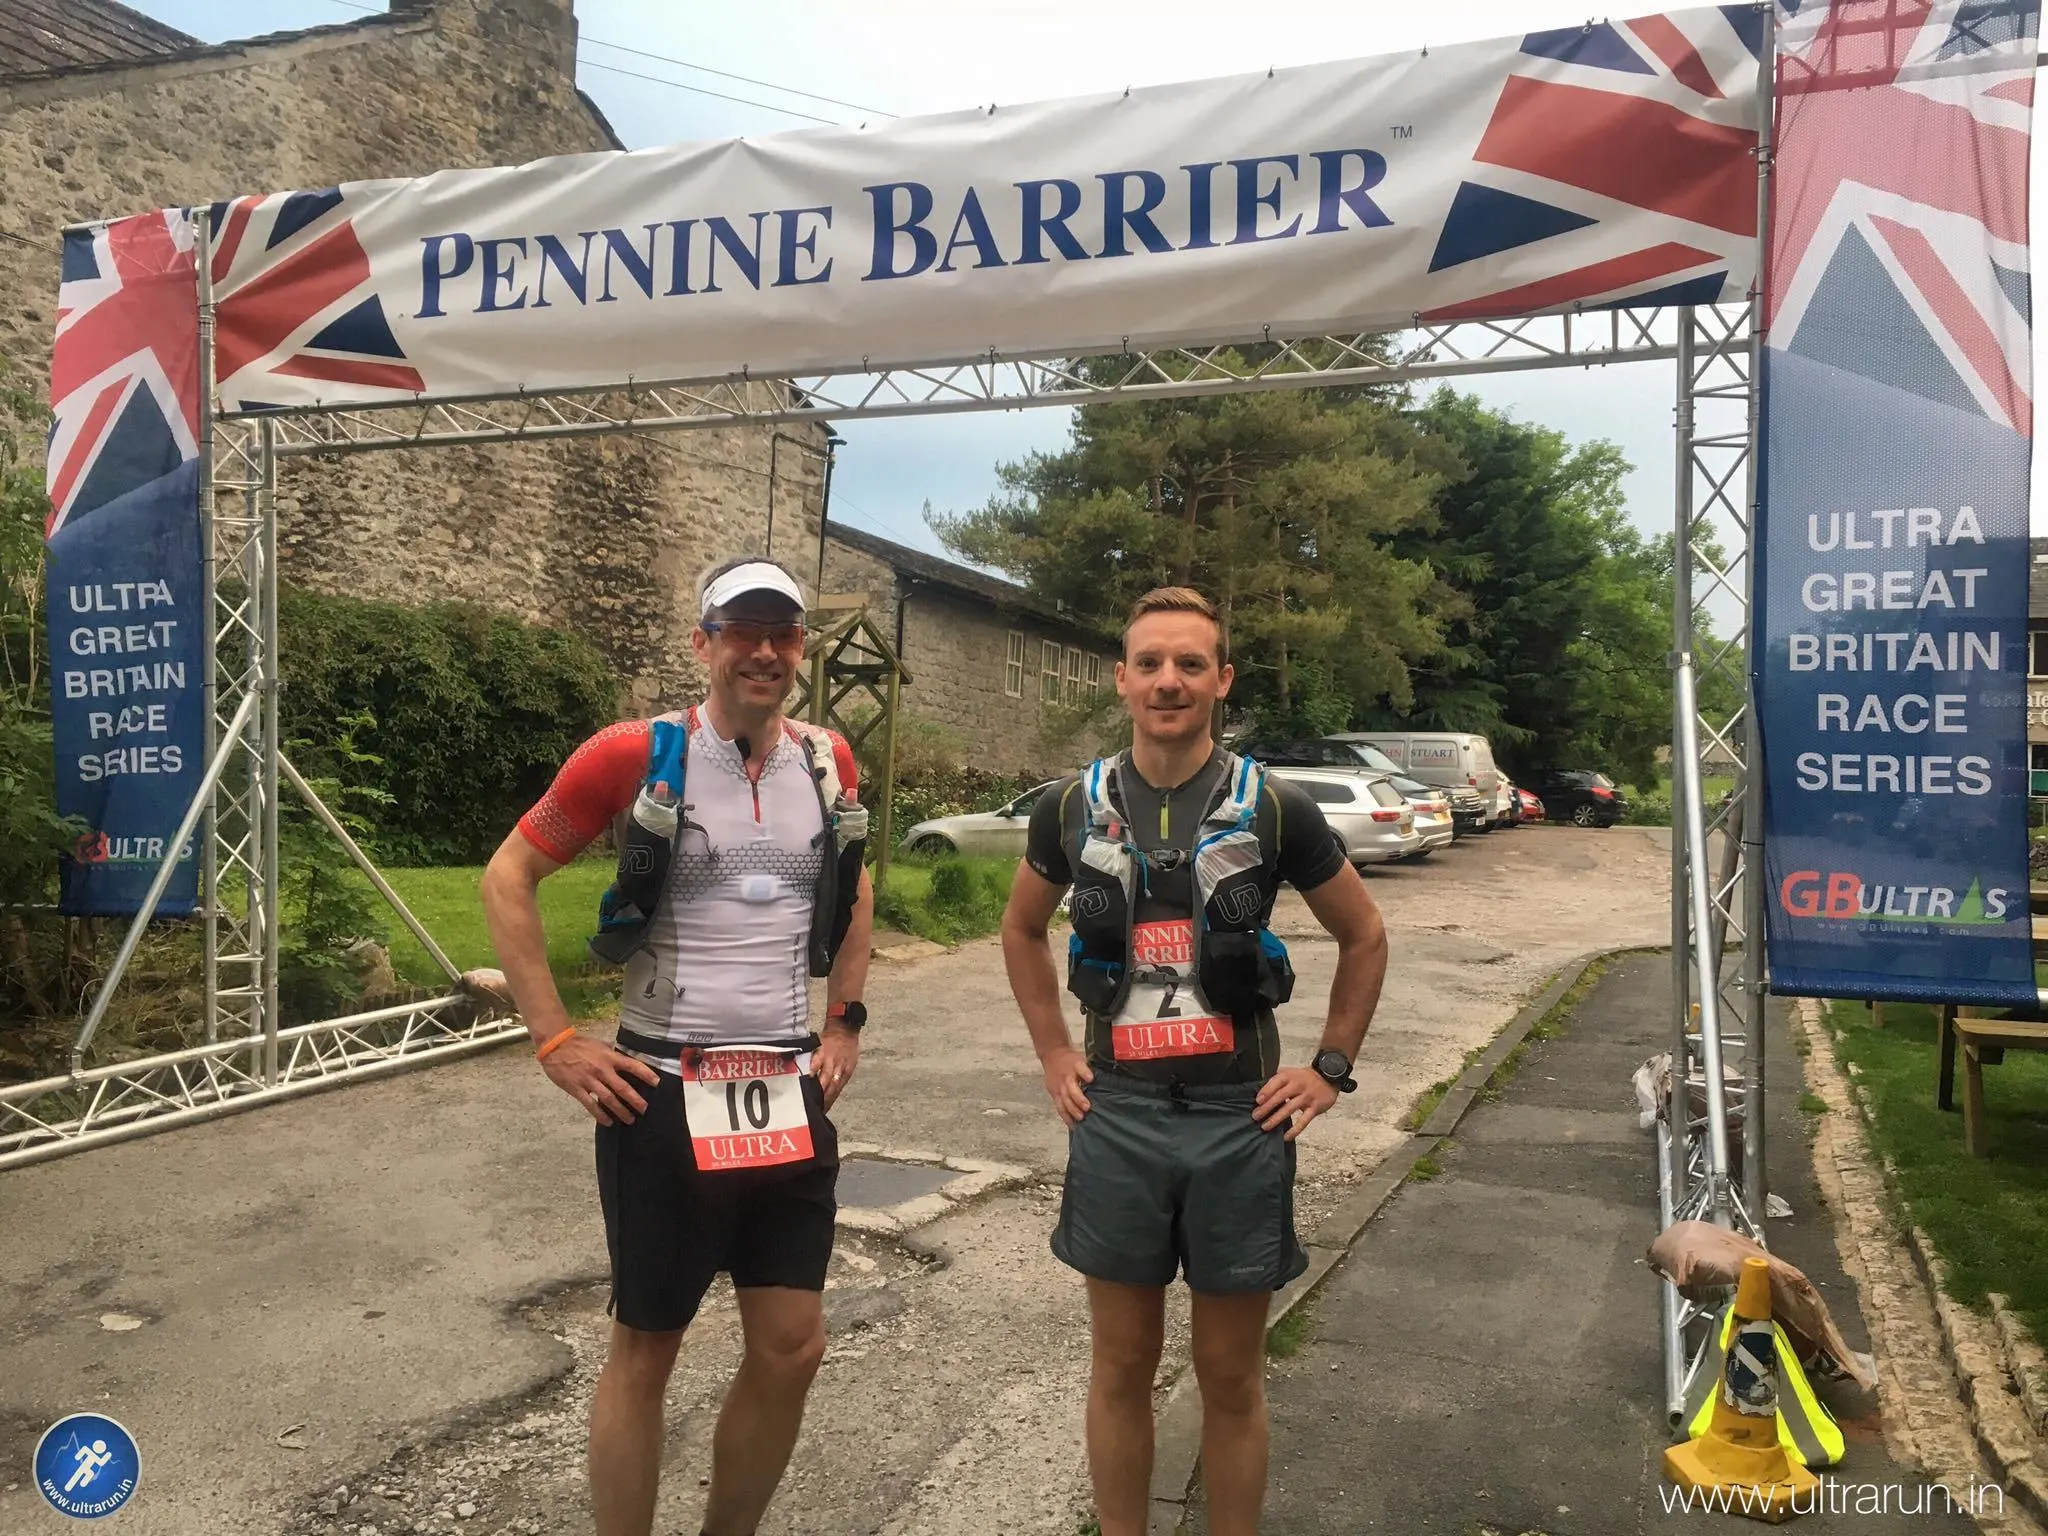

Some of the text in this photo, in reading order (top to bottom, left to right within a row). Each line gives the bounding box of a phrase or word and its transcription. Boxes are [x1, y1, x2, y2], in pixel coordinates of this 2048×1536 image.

[414, 206, 832, 318] PENNINE
[861, 148, 1394, 281] BARRIER
[1807, 506, 1985, 552] ULTRA
[69, 579, 174, 612] ULTRA
[1802, 569, 1988, 612] GREAT
[69, 621, 177, 655] GREAT
[1789, 632, 2000, 671] BRITAIN
[64, 662, 186, 698] BRITAIN
[89, 705, 167, 739] RACE
[1817, 694, 1967, 732] RACE
[78, 745, 182, 782] SERIES
[1411, 749, 1455, 758] STUART
[1797, 752, 1992, 796] SERIES
[1132, 925, 1193, 945] ENNIN
[1152, 965, 1181, 1019] 2
[1128, 1021, 1221, 1050] ULTRA
[696, 1057, 785, 1081] BARRIER
[726, 1079, 770, 1131] 10
[708, 1132, 797, 1161] ULTRA
